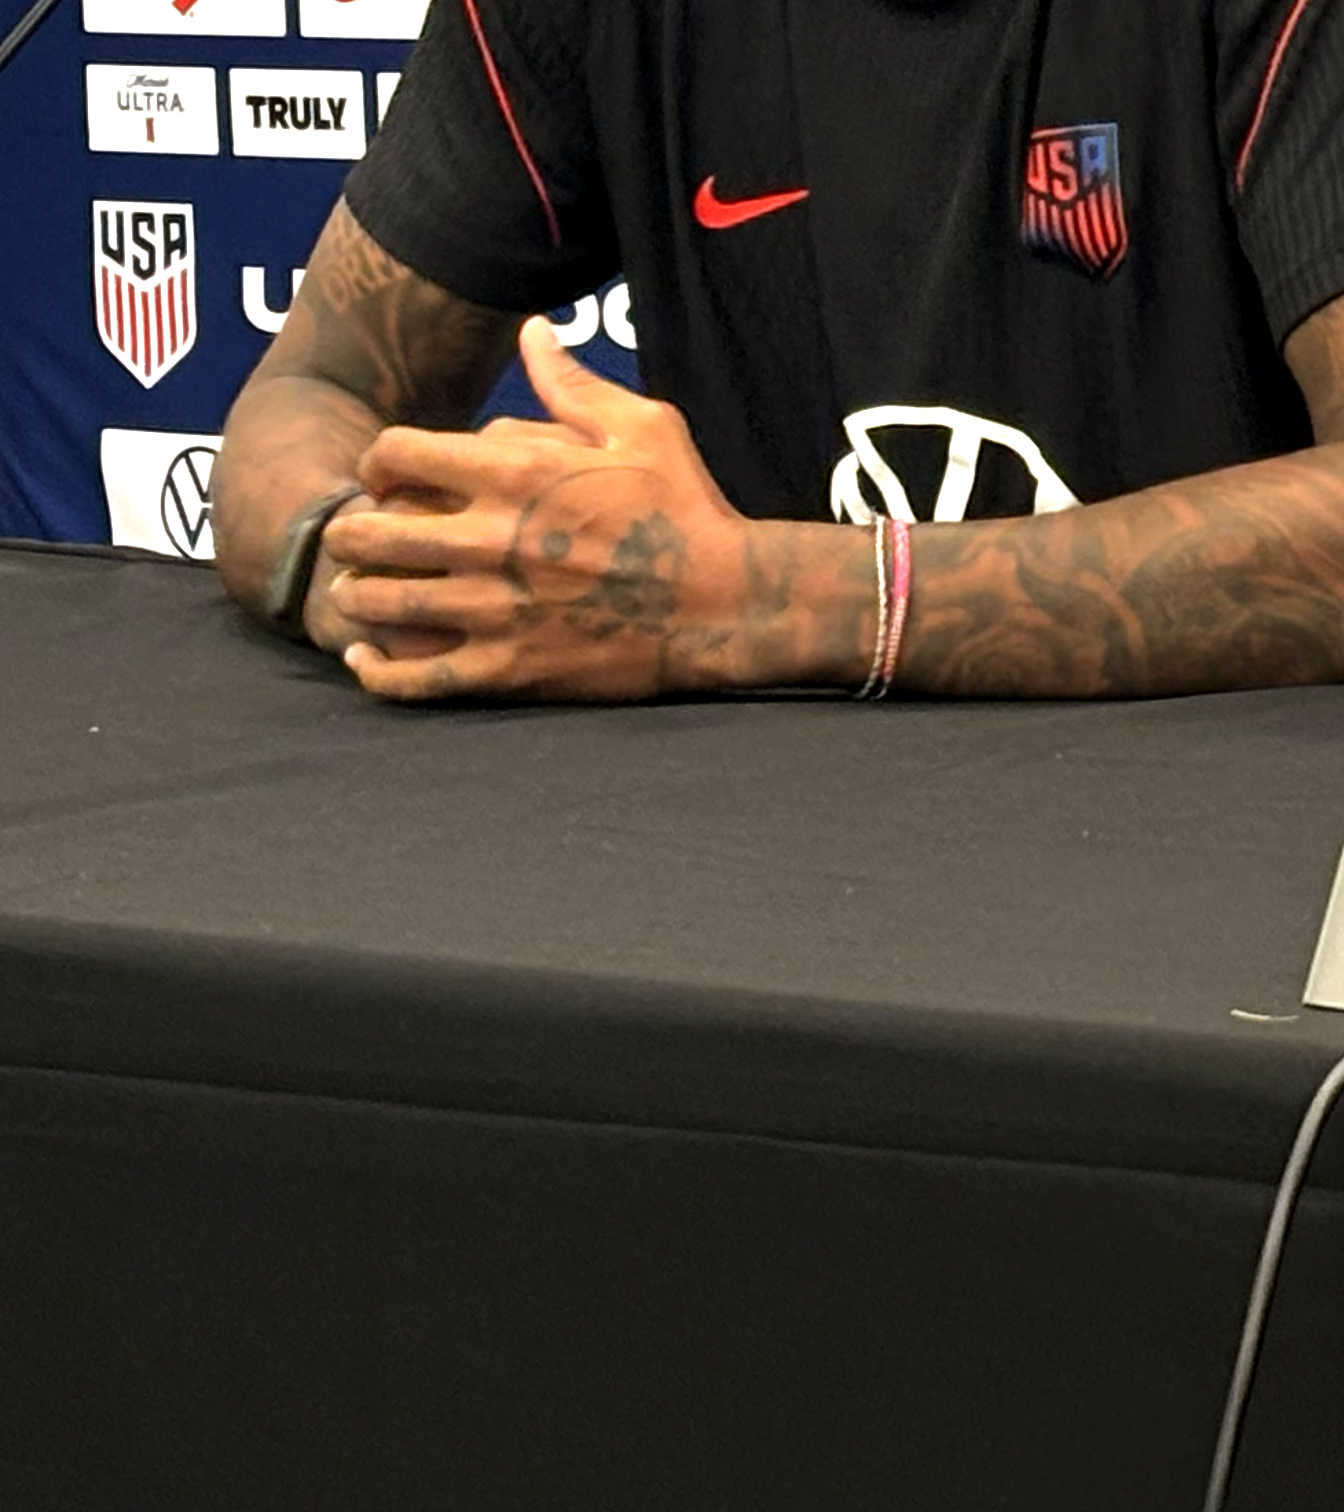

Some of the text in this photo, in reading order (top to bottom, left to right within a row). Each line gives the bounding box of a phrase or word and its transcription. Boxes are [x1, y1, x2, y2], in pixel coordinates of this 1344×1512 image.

[118, 92, 183, 112] ULTRA
[245, 95, 347, 131] TRULY
[1028, 136, 1107, 201] USA
[101, 211, 187, 280] USA
